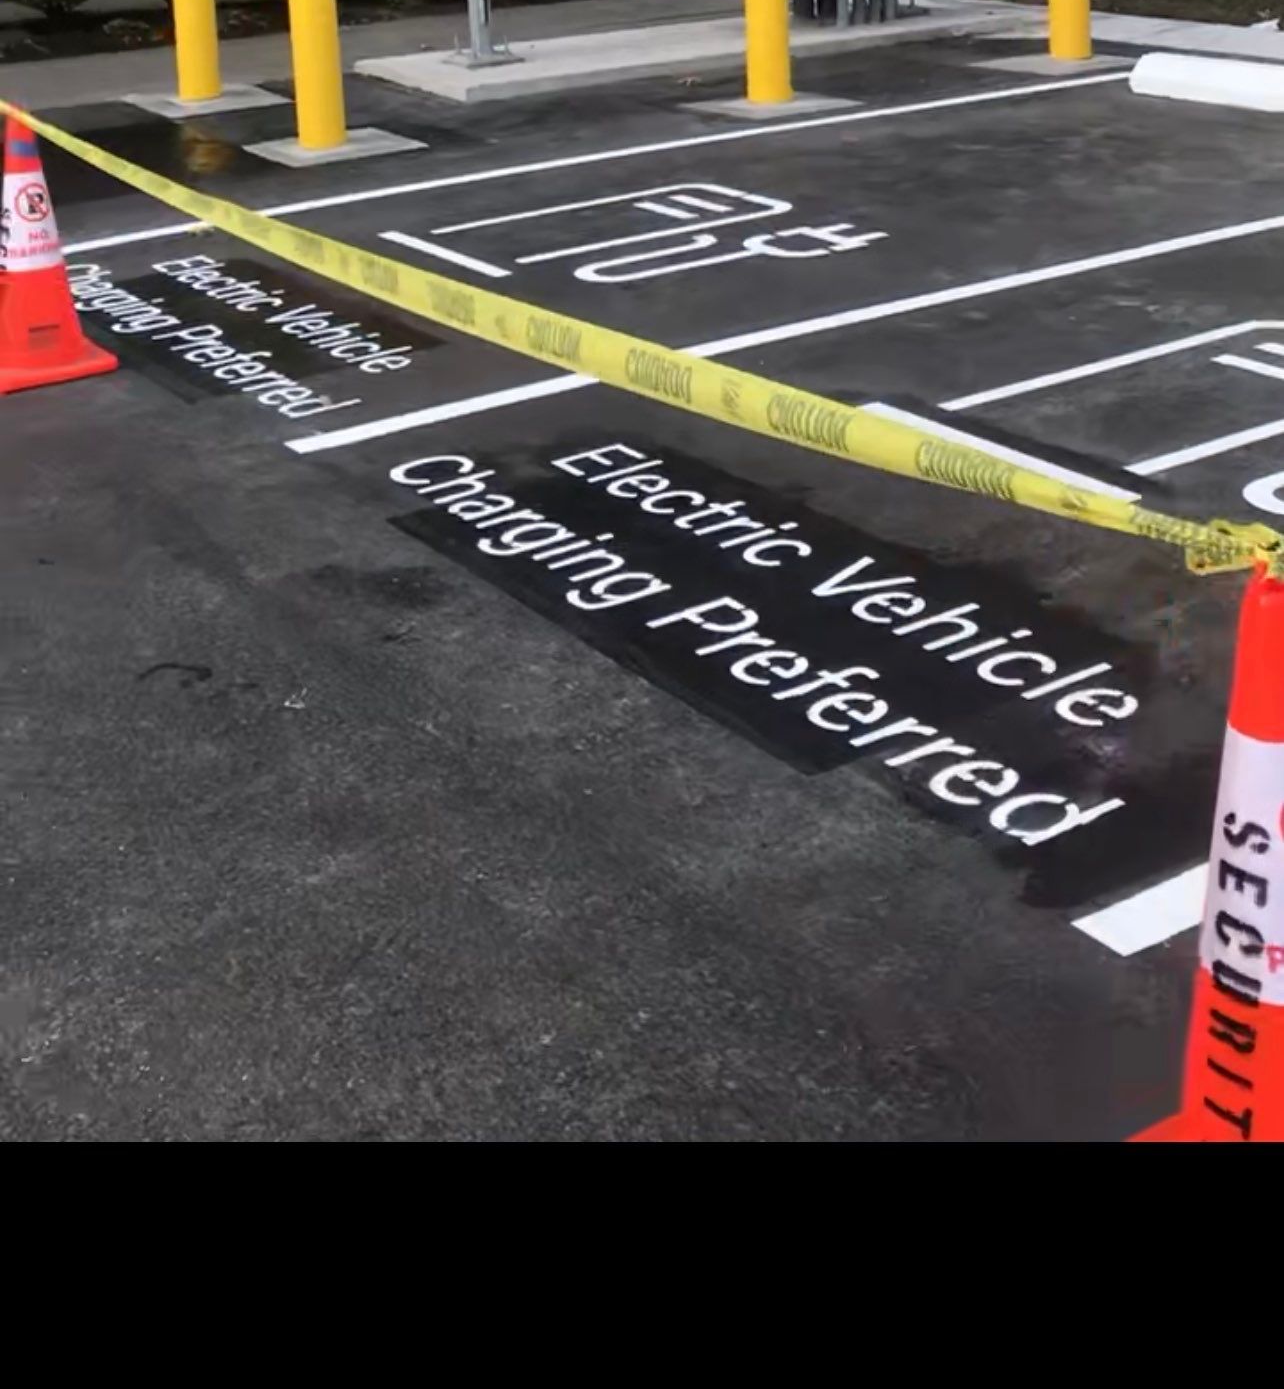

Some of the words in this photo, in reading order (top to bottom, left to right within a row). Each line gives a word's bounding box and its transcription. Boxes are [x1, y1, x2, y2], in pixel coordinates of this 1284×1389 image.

[65, 264, 181, 333] Charging
[152, 324, 362, 418] Preferred
[152, 255, 281, 311] Electric
[266, 304, 412, 373] Vehicle
[389, 454, 671, 611] Charging
[646, 596, 1126, 847] Preferred
[551, 443, 812, 567] Electric
[811, 555, 1138, 727] Vehicle
